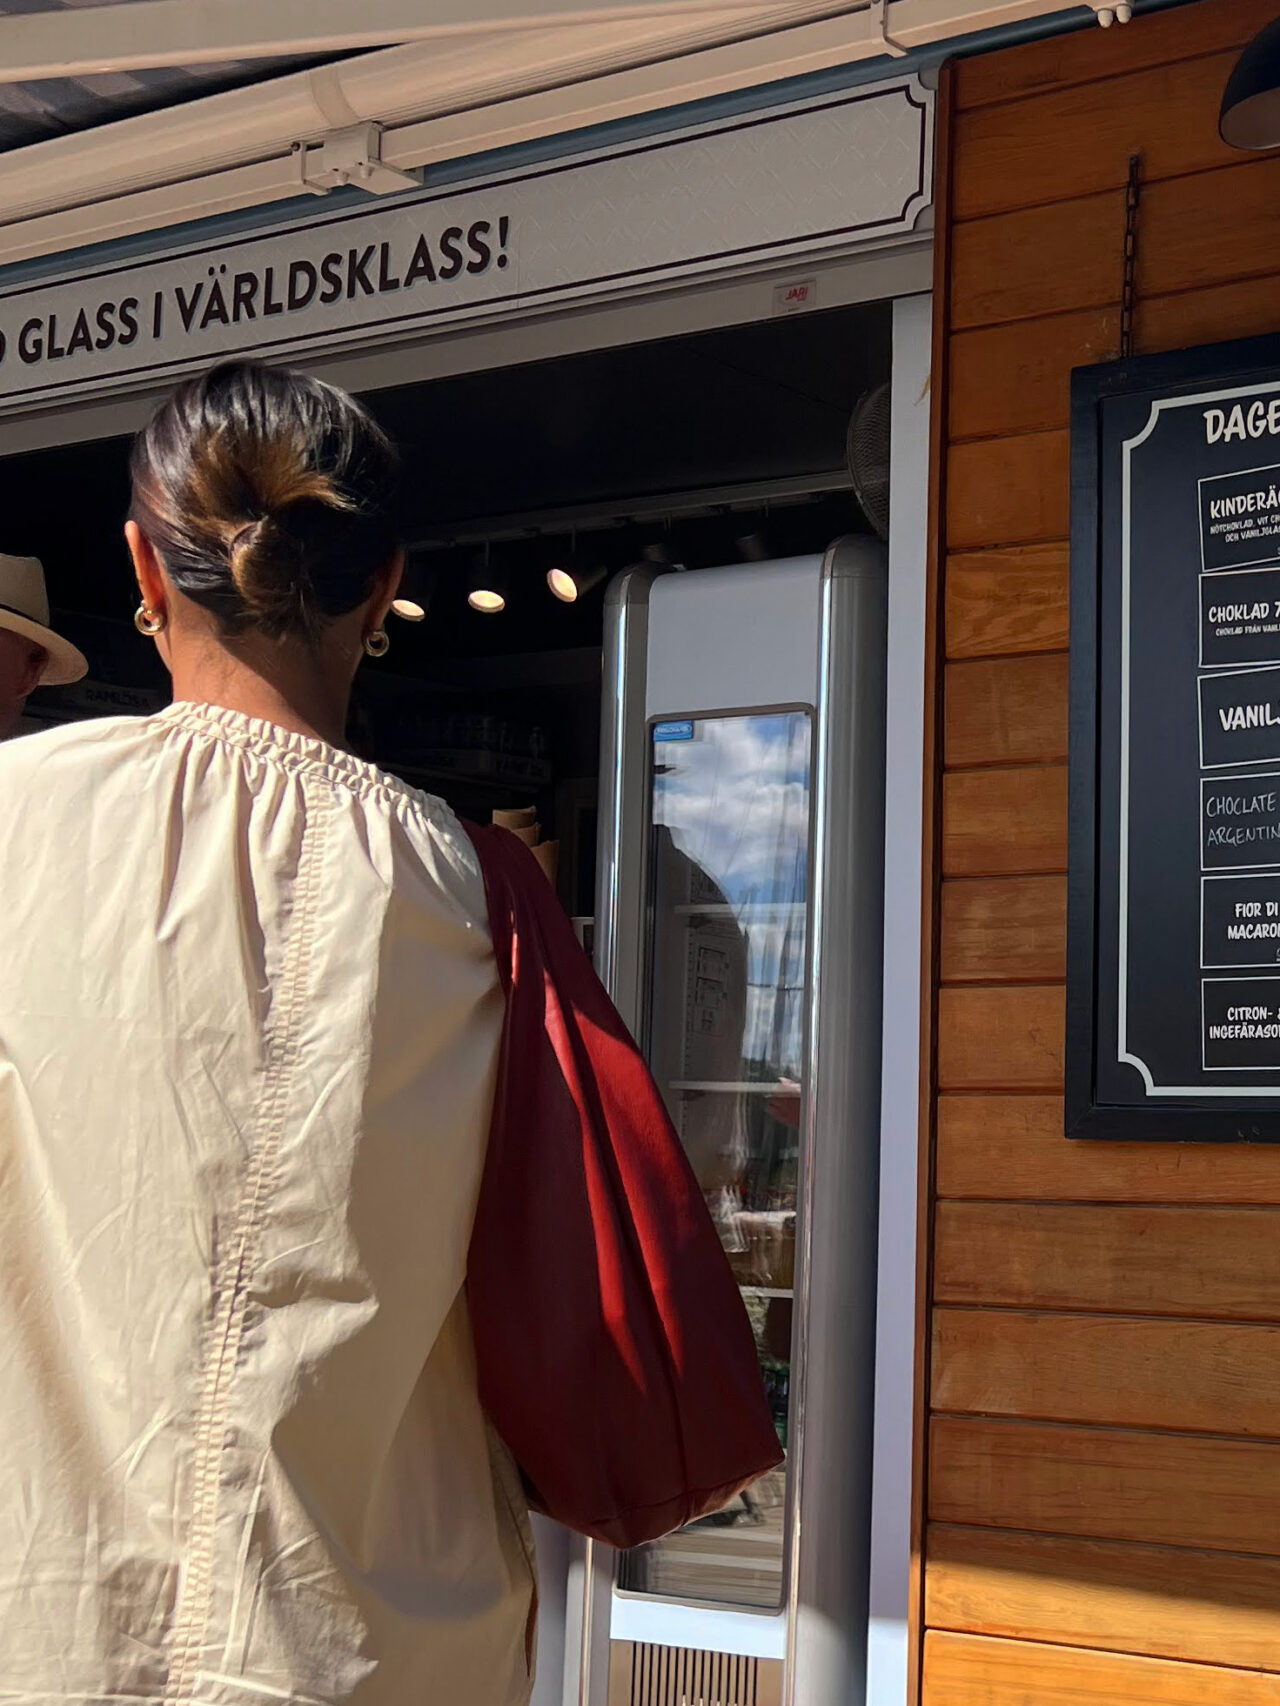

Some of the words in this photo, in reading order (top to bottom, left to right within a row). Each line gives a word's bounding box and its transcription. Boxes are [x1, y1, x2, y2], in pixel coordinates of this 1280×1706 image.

[18, 297, 139, 364] GLASS
[153, 291, 163, 339] I
[175, 216, 509, 333] VÄRLDSKLASS!
[1257, 515, 1269, 526] VIT
[1225, 532, 1239, 543] OCH
[1208, 602, 1270, 623] CHOKLAD
[1215, 626, 1243, 637] CHOKLAD
[1206, 792, 1277, 817] CHOCLATE
[1235, 902, 1262, 918] FIOR
[1266, 901, 1279, 917] DI
[1227, 1006, 1273, 1021] CITRON-
